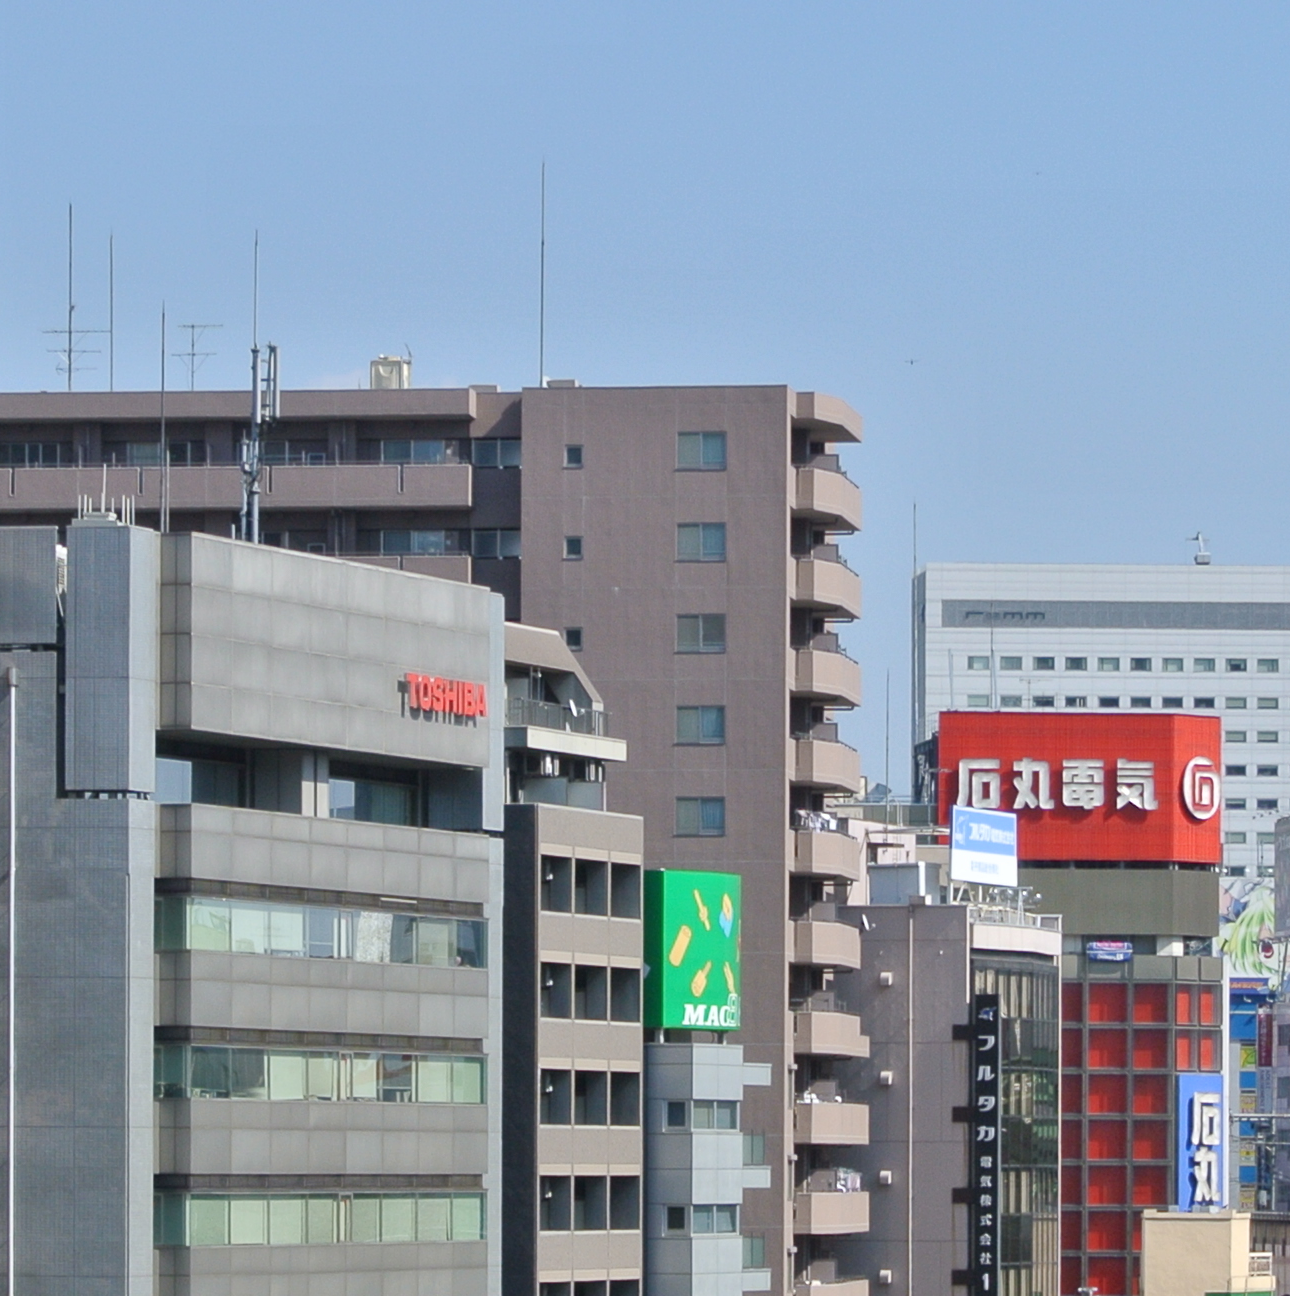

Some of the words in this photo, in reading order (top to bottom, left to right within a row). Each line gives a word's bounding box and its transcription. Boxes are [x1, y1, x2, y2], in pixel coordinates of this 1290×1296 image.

[405, 673, 487, 717] TOSHIBA
[956, 757, 1158, 811] 石丸電気
[1191, 1091, 1221, 1202] 石丸
